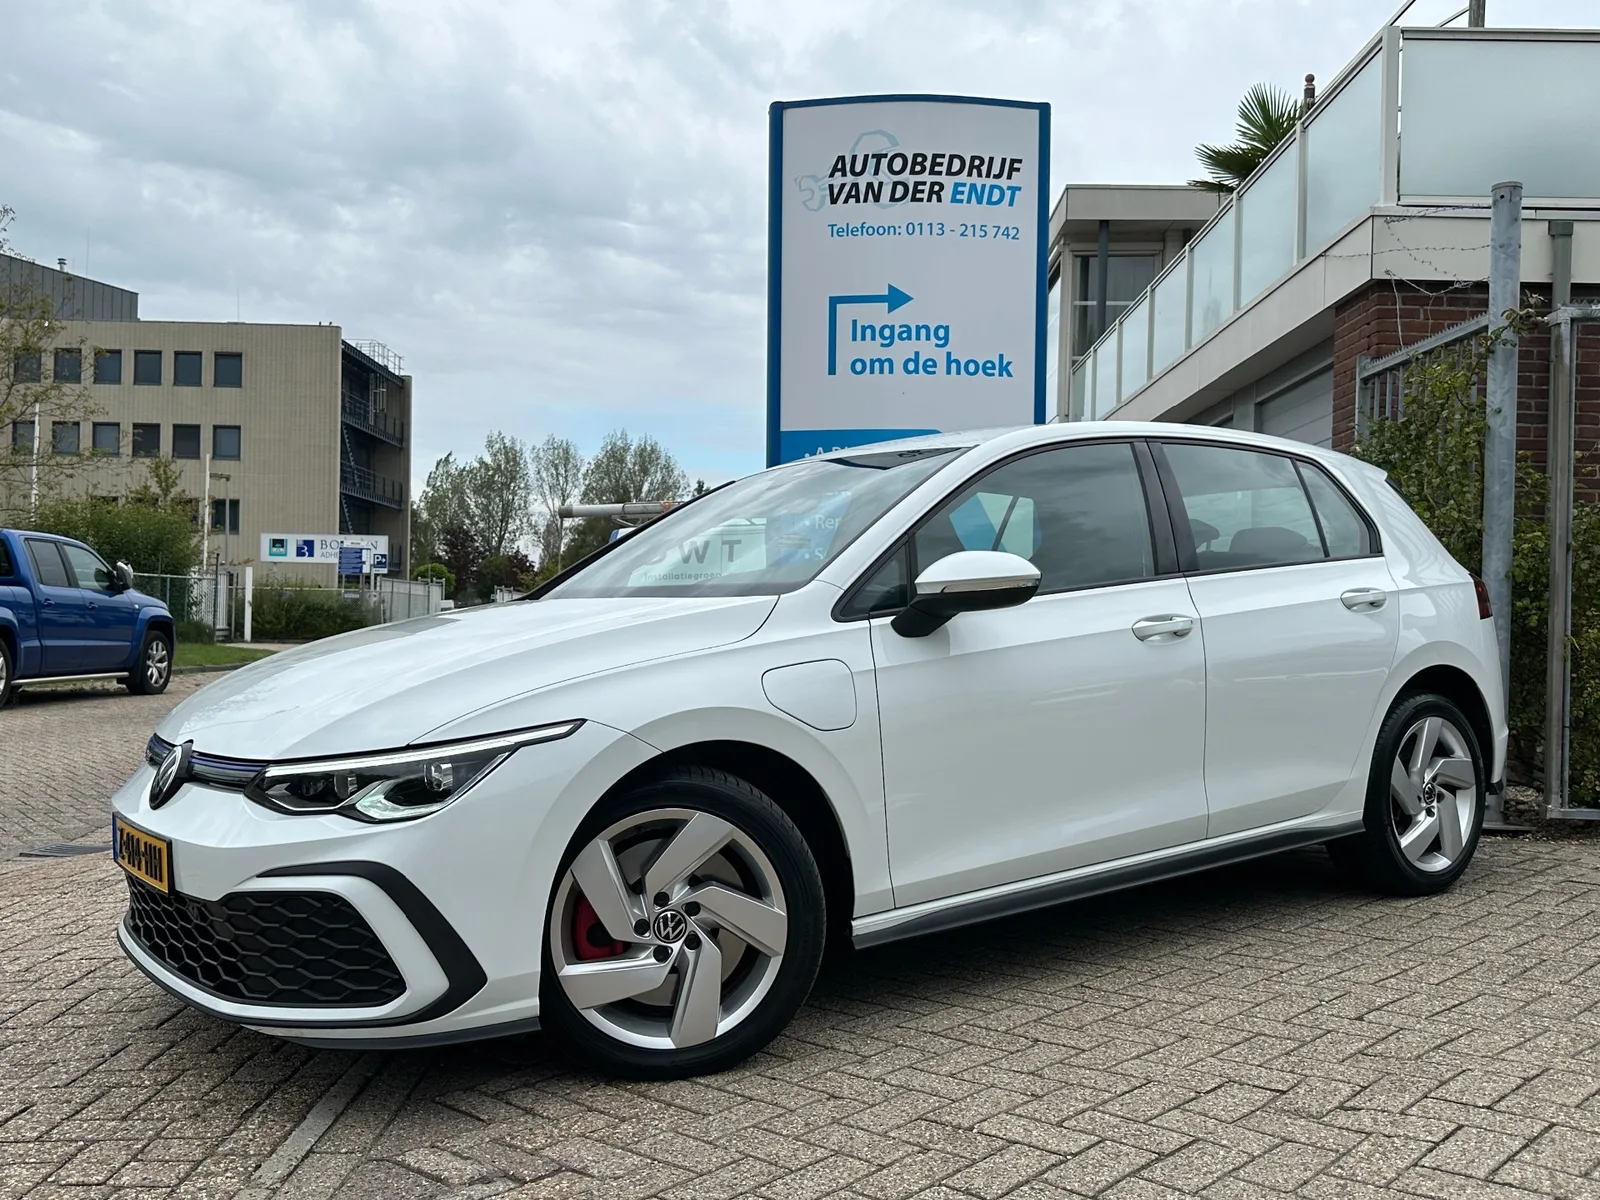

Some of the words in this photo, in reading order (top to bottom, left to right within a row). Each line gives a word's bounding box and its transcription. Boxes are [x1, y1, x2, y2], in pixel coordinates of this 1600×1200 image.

[828, 153, 1023, 181] AUTOBEDRIJF
[828, 182, 884, 205] VAN
[889, 181, 945, 204] DER
[949, 182, 1022, 208] ENDT
[827, 222, 902, 238] Telefoon:
[905, 221, 945, 237] 0113
[959, 223, 988, 239] 215
[991, 225, 1020, 241] 742
[850, 319, 950, 348] Ingang
[849, 354, 895, 377] om
[901, 350, 938, 377] de
[944, 351, 1014, 379] hoek
